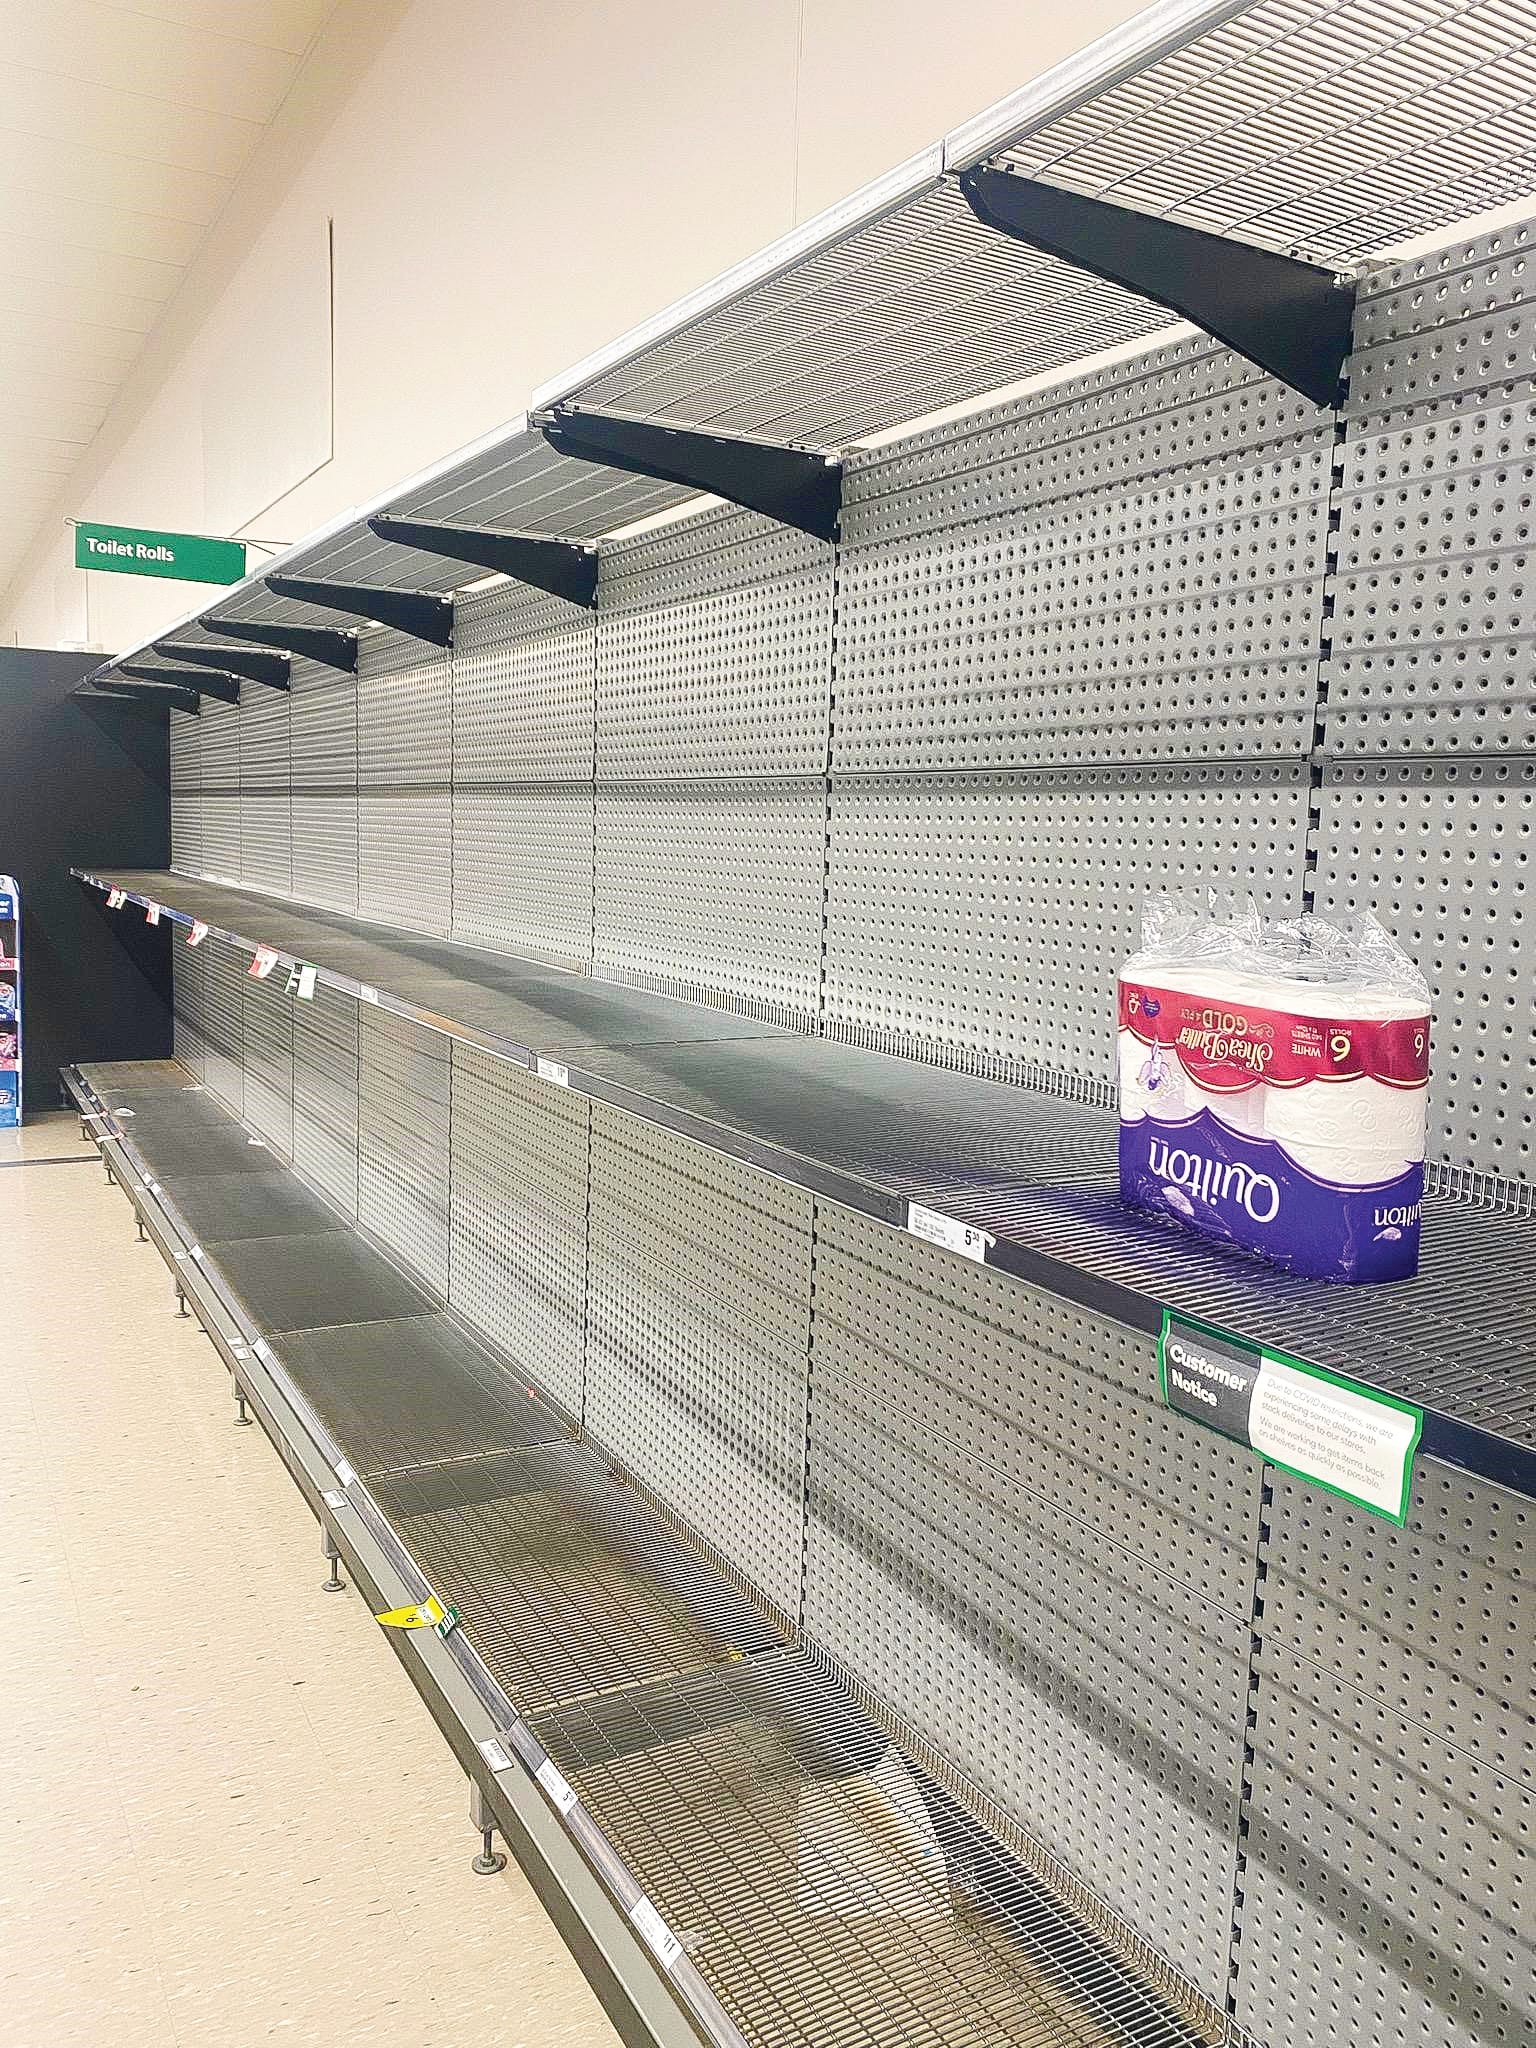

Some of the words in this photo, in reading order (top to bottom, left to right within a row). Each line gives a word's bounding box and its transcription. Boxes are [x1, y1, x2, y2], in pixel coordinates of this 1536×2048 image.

[86, 538, 134, 557] Toilet
[136, 544, 174, 561] Rolls
[1202, 1009, 1247, 1035] GOLD
[1330, 1028, 1352, 1036] ROLLS
[1176, 1027, 1229, 1060] Butter
[1229, 1038, 1273, 1072] Shea
[1292, 1043, 1321, 1058] WHITE
[1330, 1035, 1350, 1062] 6
[1414, 1034, 1424, 1058] 6
[1148, 1141, 1280, 1223] Quilton
[1374, 1200, 1423, 1226] uilton
[1170, 1344, 1247, 1392] Customer
[1171, 1370, 1218, 1406] Notice
[1263, 1391, 1308, 1417] experiencing
[1310, 1411, 1330, 1425] some
[1332, 1419, 1357, 1439] delays
[1359, 1431, 1376, 1446] with
[1267, 1377, 1280, 1391] Due
[1284, 1385, 1291, 1395] to
[1292, 1388, 1320, 1408] COVID
[1365, 1422, 1376, 1432] we
[1378, 1428, 1393, 1439] are
[1261, 1401, 1279, 1414] stock
[1281, 1409, 1314, 1431] deliveries
[1317, 1425, 1325, 1435] to
[1326, 1430, 1338, 1441] our
[1341, 1436, 1365, 1454] stores.
[1259, 1415, 1272, 1429] We
[1273, 1423, 1285, 1434] are
[1286, 1428, 1316, 1449] working
[1318, 1441, 1325, 1451] to
[1365, 1463, 1384, 1479] back
[1259, 1429, 1267, 1438] on
[1297, 1446, 1305, 1454] as
[1308, 1450, 1333, 1469] quickly
[1335, 1464, 1345, 1473] as
